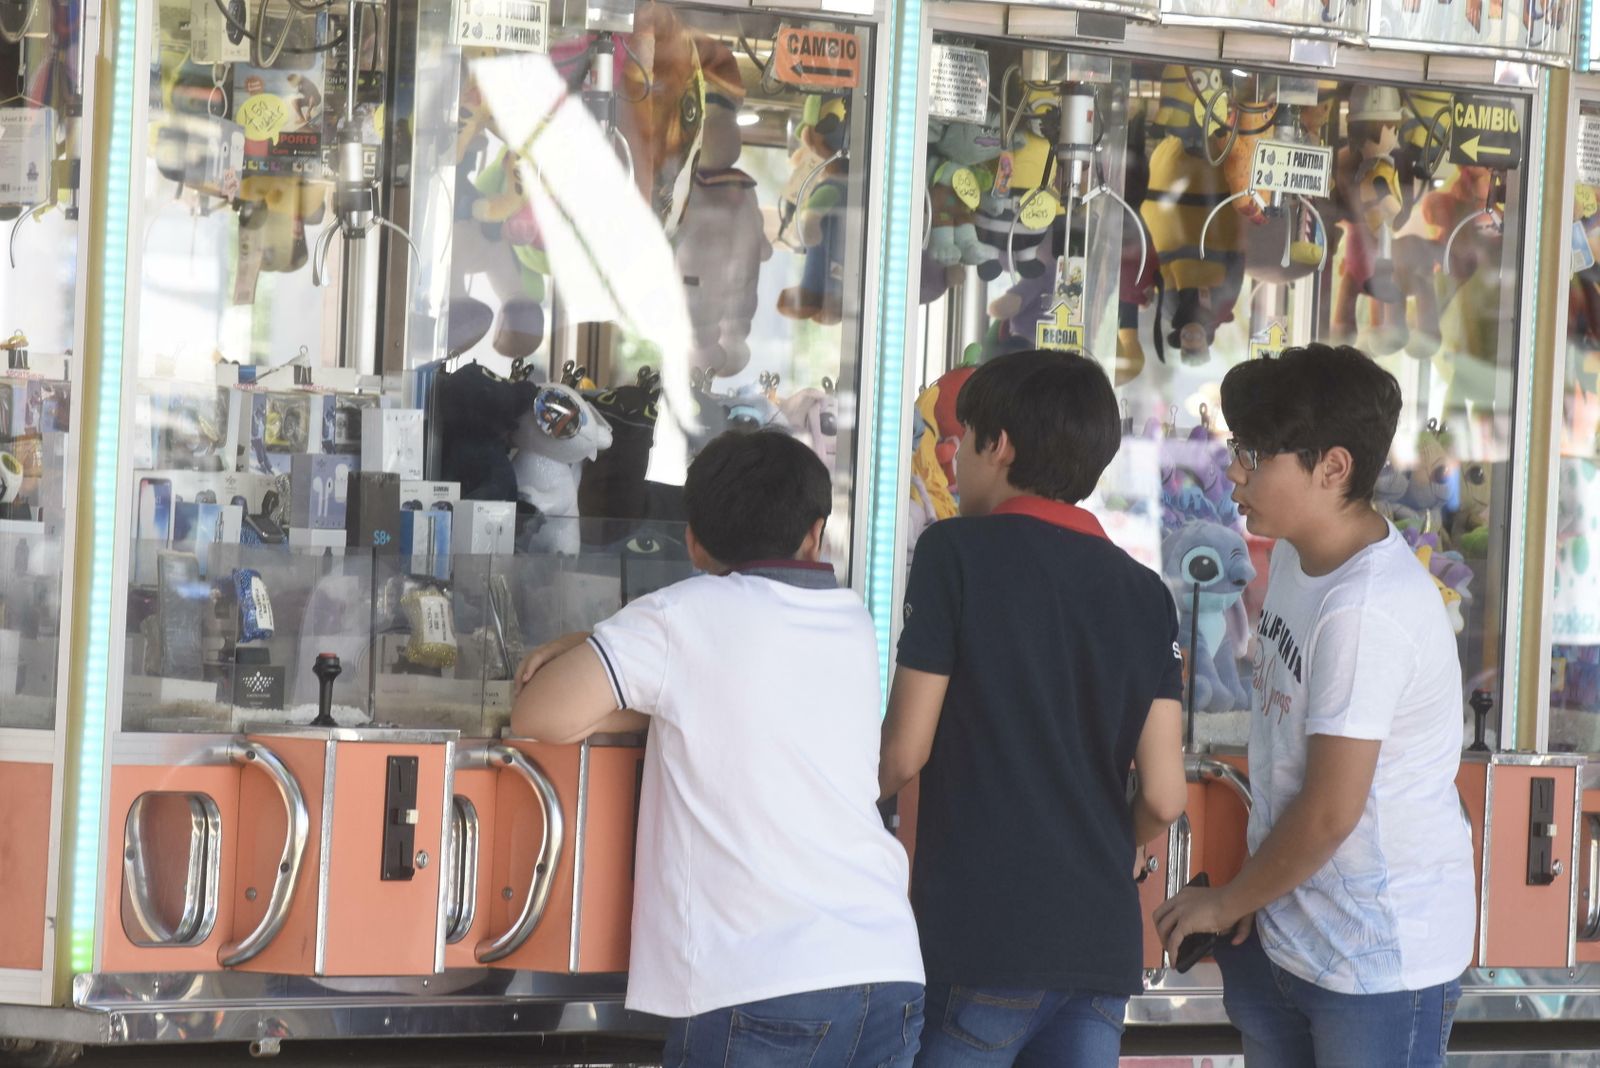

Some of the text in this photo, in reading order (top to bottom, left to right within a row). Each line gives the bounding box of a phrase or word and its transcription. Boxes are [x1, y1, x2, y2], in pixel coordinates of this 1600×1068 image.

[505, 3, 541, 23] PARTIDA
[462, 22, 541, 46] 2 3 PARTIDAS
[787, 33, 857, 60] CAMBIO
[1454, 102, 1519, 134] CAMBIO
[280, 134, 318, 145] PORTS
[1260, 149, 1324, 171] 1 1 PARTIDA
[1256, 170, 1322, 192] 2 3 PARTIDAS
[1042, 328, 1078, 345] RECOJA
[1257, 609, 1302, 685] ALIFORNIA
